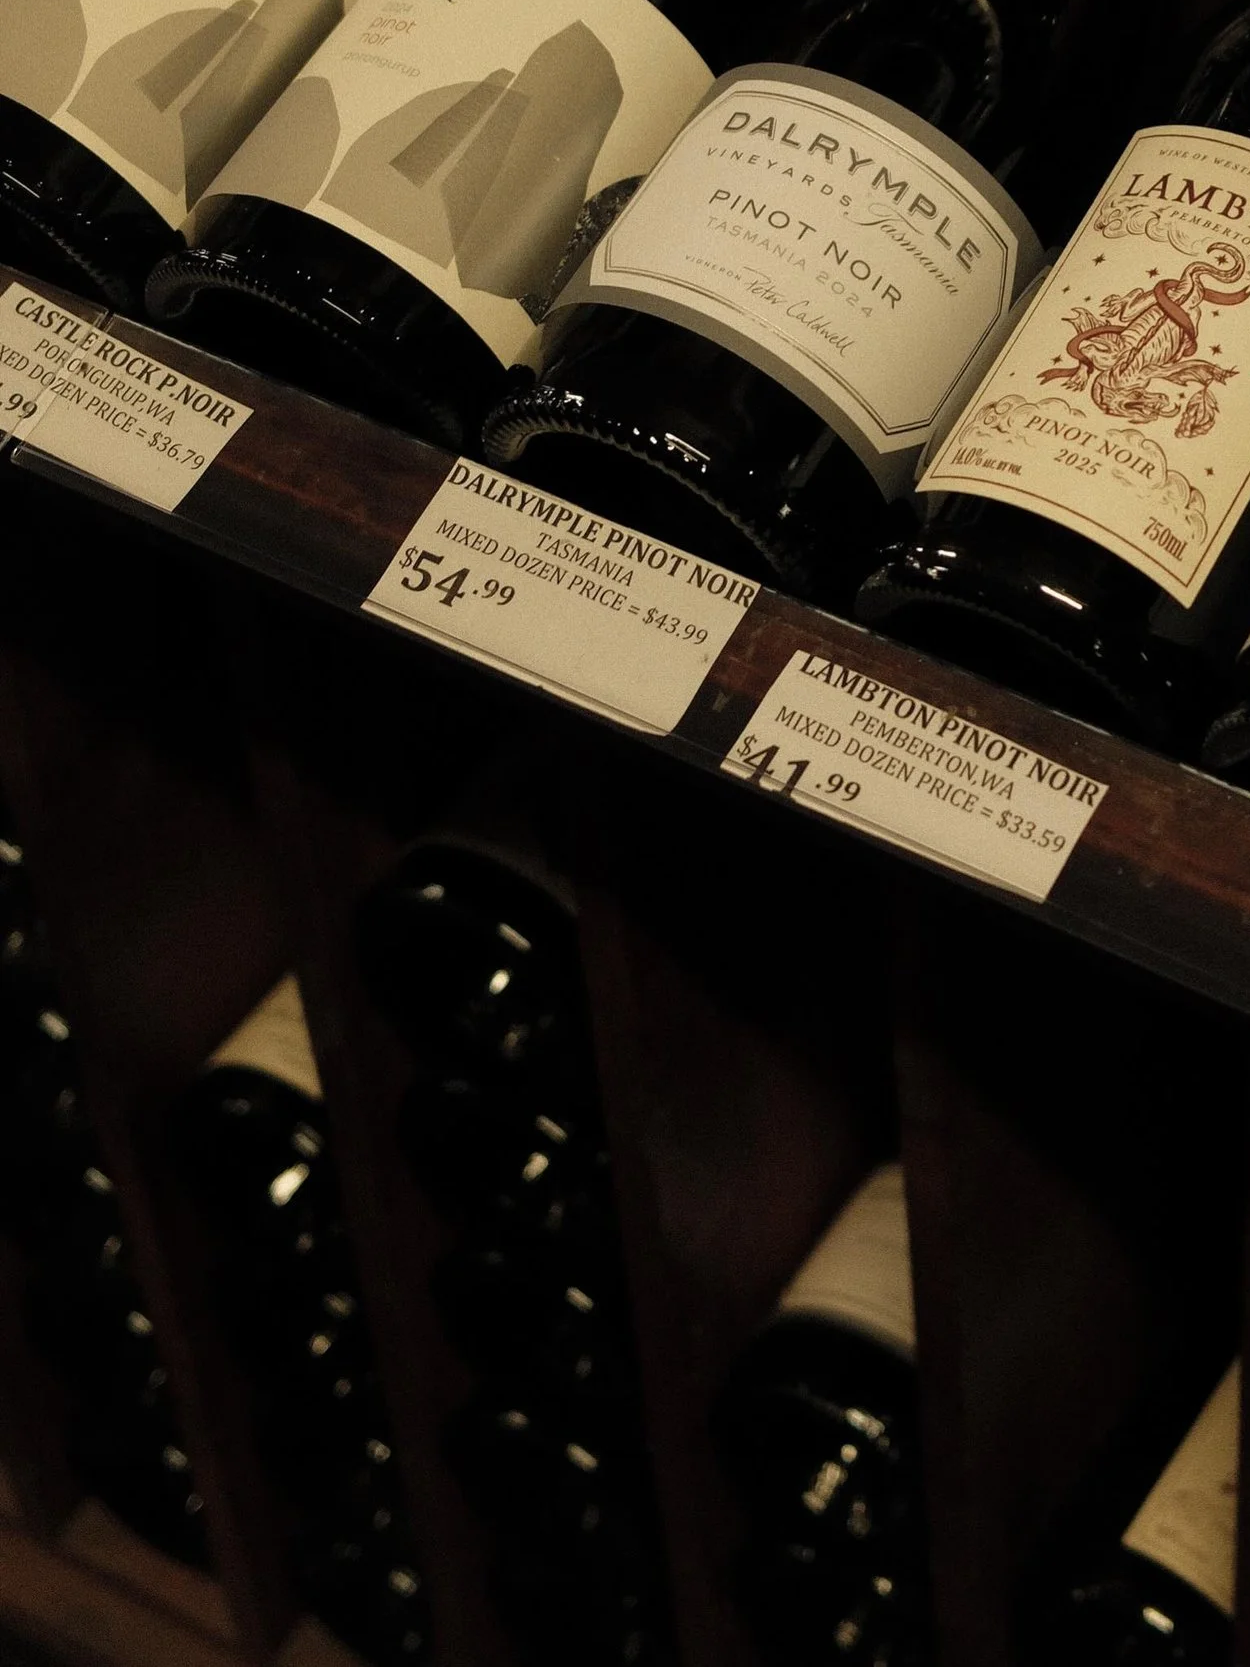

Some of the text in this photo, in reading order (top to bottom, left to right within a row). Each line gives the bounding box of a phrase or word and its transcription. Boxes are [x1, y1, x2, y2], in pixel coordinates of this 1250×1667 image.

[358, 31, 393, 46] noir
[368, 16, 417, 34] pinot
[706, 146, 852, 209] VINEYARDS
[721, 110, 982, 275] DALRYMPLE
[1158, 148, 1190, 159] WINE
[1191, 152, 1208, 162] OF
[705, 215, 874, 319] TASMANIA 2024
[708, 189, 903, 310] PINOT NOIR
[0, 386, 38, 420] .99
[15, 297, 237, 428] CASTLE ROCK P.NOIR
[34, 338, 175, 427] PORONGURUP,WA
[28, 364, 88, 405] DOZEN
[85, 396, 138, 433] PRICE
[147, 430, 206, 471] $36.79
[1024, 414, 1157, 480] PINOT NOIR
[1053, 448, 1104, 477] 2025
[446, 462, 757, 609] DALRYMPLE PINOT NOIR
[535, 532, 636, 588] TASMANIA
[436, 518, 499, 557] MIXED
[499, 546, 569, 589] DOZEN
[568, 574, 628, 613] PRICE
[641, 607, 710, 647] $43.99
[797, 653, 1101, 808] LAMBTON PINOT NOIR
[848, 708, 1016, 801] PEMBERTON,WA
[774, 705, 842, 747] MIXED
[842, 737, 915, 783] DOZEN
[914, 771, 980, 815] PRICE
[995, 809, 1067, 855] $33.59
